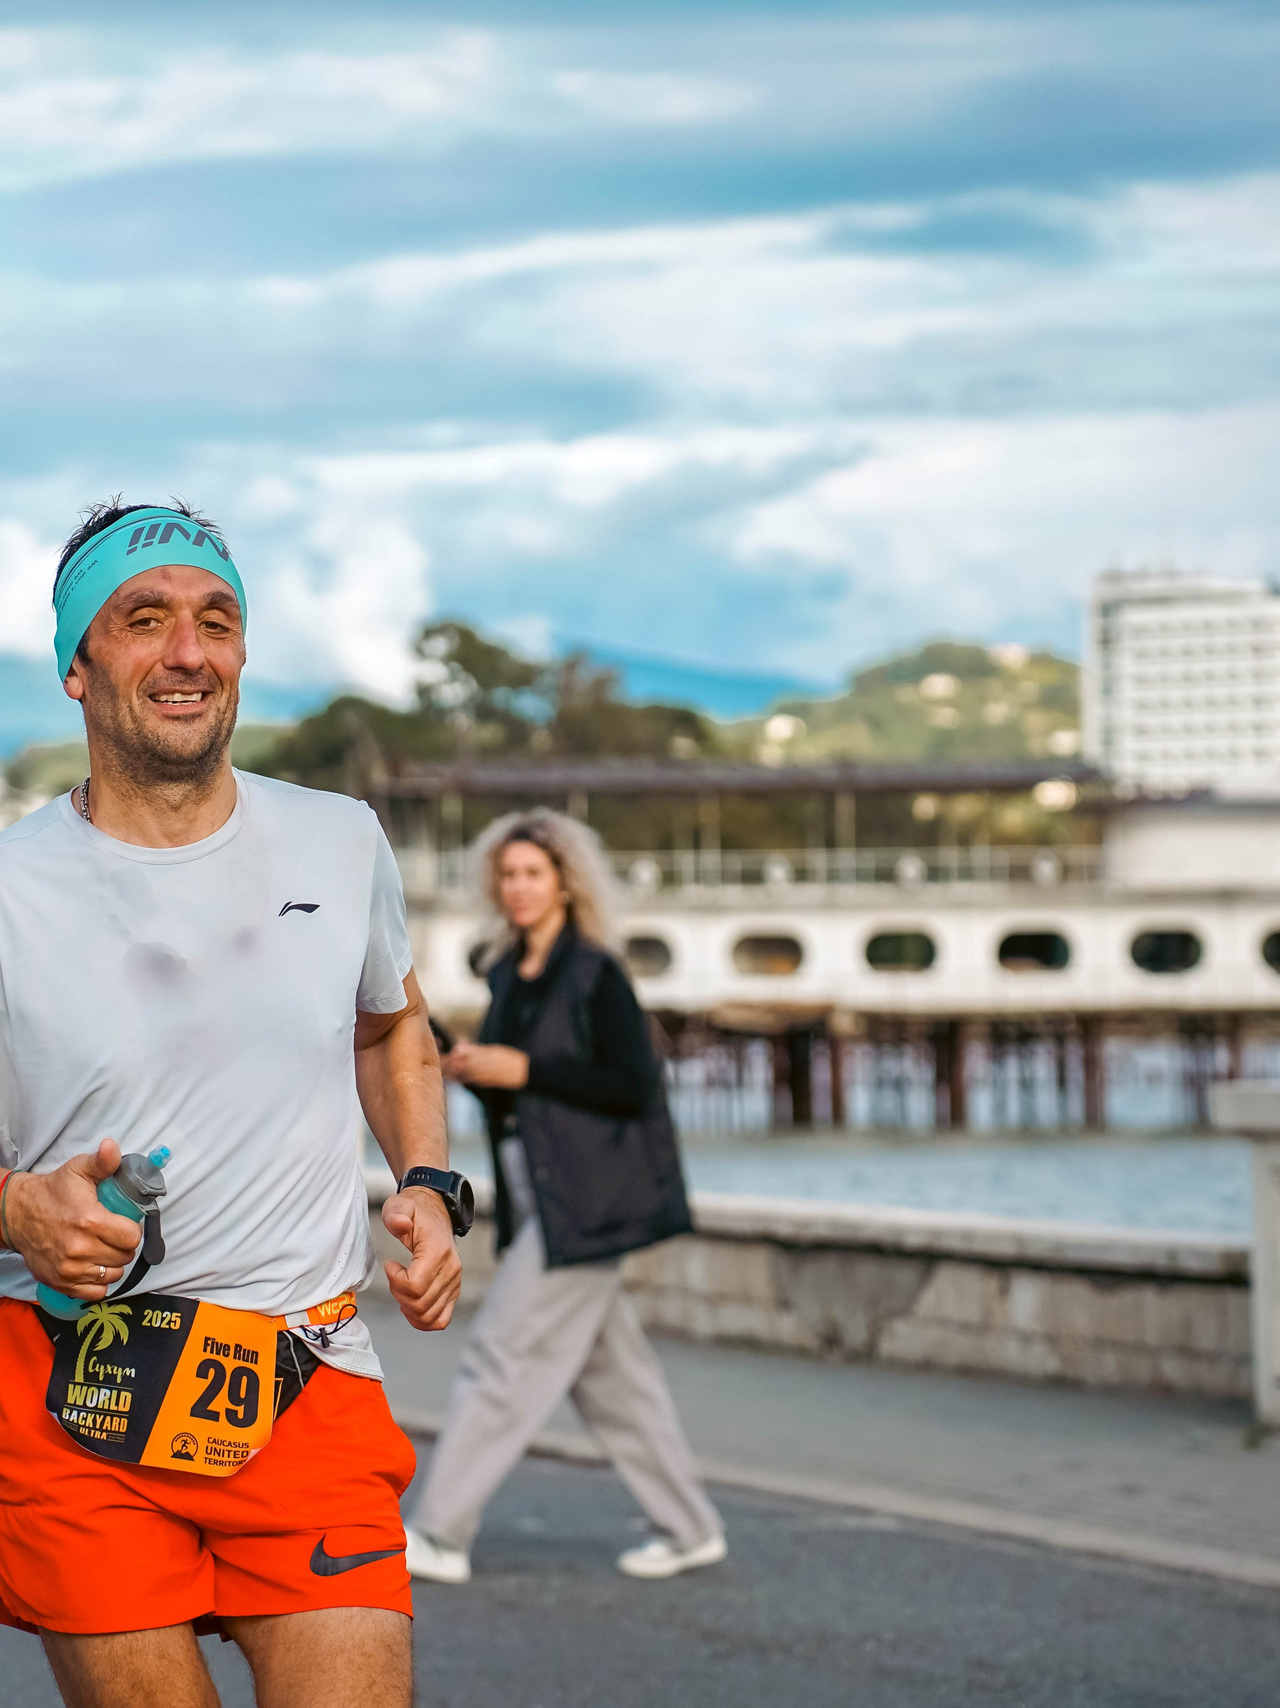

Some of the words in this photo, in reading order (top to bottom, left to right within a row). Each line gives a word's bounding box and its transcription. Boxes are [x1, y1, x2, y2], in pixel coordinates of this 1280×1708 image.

[141, 1309, 182, 1330] 2025
[202, 1336, 231, 1358] Five
[232, 1343, 259, 1365] Run
[67, 1383, 132, 1412] WORLD
[189, 1358, 260, 1429] 29
[61, 1407, 128, 1433] BACKYARD
[79, 1427, 107, 1440] ULTRA
[207, 1436, 250, 1449] CAUCASUS
[205, 1445, 249, 1459] UNITED
